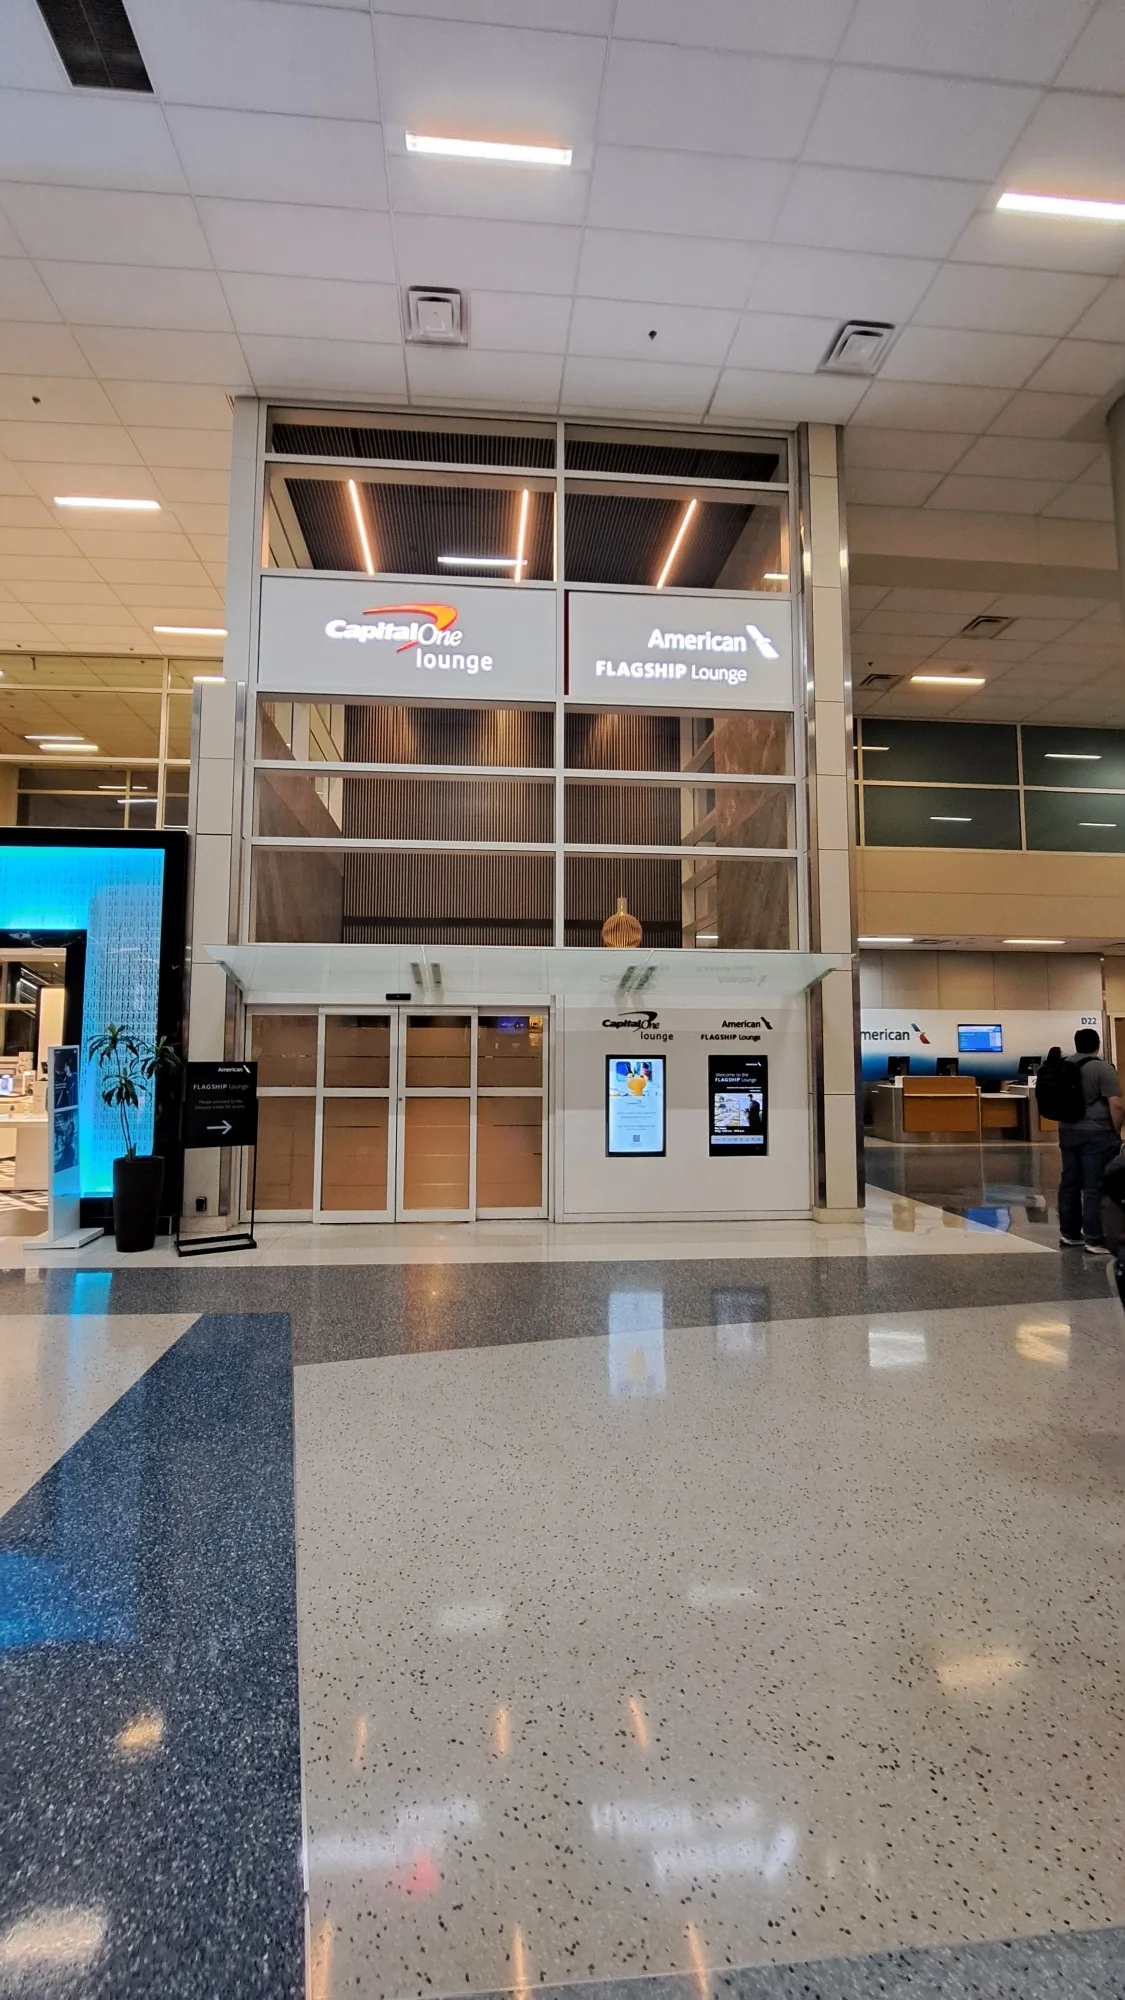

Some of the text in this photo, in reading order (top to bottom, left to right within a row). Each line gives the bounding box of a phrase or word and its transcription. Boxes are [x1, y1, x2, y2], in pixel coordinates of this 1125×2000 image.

[647, 628, 747, 652] American
[416, 648, 493, 675] lounge
[595, 660, 748, 685] FLAGSHIP Lounge
[721, 1020, 761, 1029] American
[1081, 1017, 1097, 1025] D22
[640, 1032, 674, 1042] lounge
[738, 1034, 761, 1042] Lounge
[860, 1029, 910, 1041] merican
